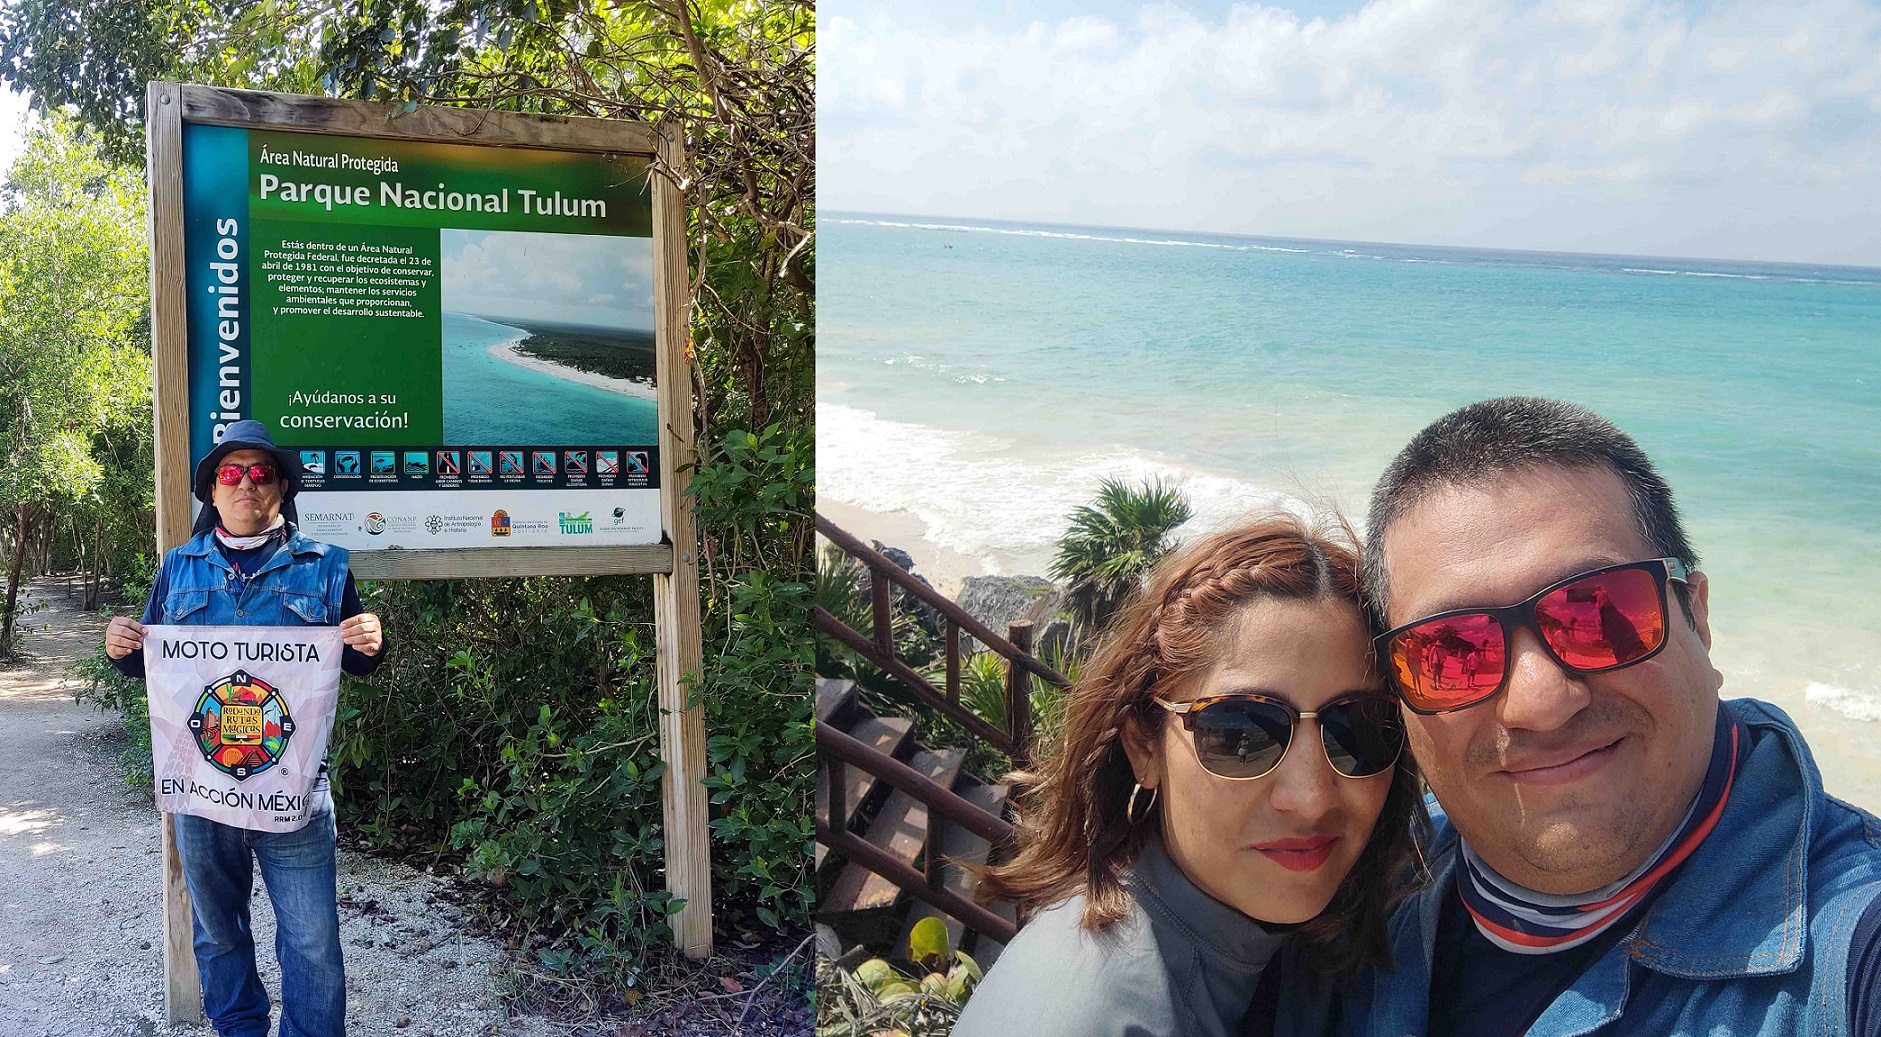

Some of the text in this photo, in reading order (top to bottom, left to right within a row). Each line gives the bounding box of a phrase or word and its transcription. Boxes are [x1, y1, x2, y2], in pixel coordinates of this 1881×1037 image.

[260, 144, 398, 175] Área Natural Protegida
[260, 174, 606, 218] Parque Nacional Tulum
[282, 240, 304, 249] Estás
[306, 241, 334, 251] dentro
[336, 243, 346, 251] de
[360, 242, 380, 253] Área
[382, 245, 412, 254] Natural
[264, 250, 304, 261] Protegida
[307, 253, 339, 262] Federal,
[342, 254, 355, 262] fue
[357, 255, 398, 264] decretada
[400, 256, 407, 264] el
[409, 257, 419, 265] 23
[295, 263, 317, 271] 1981
[345, 266, 379, 274] objetivo
[393, 269, 434, 277] conservar,
[268, 274, 305, 283] proteger
[314, 276, 354, 284] recuperar
[356, 276, 368, 284] los
[370, 278, 419, 286] ecosistemas
[279, 284, 325, 293] elementos;
[368, 287, 380, 295] los
[382, 288, 417, 296] servicios
[286, 296, 337, 304] ambientales
[280, 307, 321, 315] promover
[333, 307, 374, 316] desarrollo
[375, 309, 424, 318] sustentable.
[289, 390, 396, 406] ¡Ayúdanos a su
[280, 410, 408, 428] conservación!
[304, 513, 354, 522] SEMARNAT
[559, 524, 592, 534] TULUM
[163, 640, 320, 662] MOTO TURISTA
[284, 723, 291, 731] E
[162, 779, 184, 794] EN
[190, 781, 253, 809] ACCIÓN
